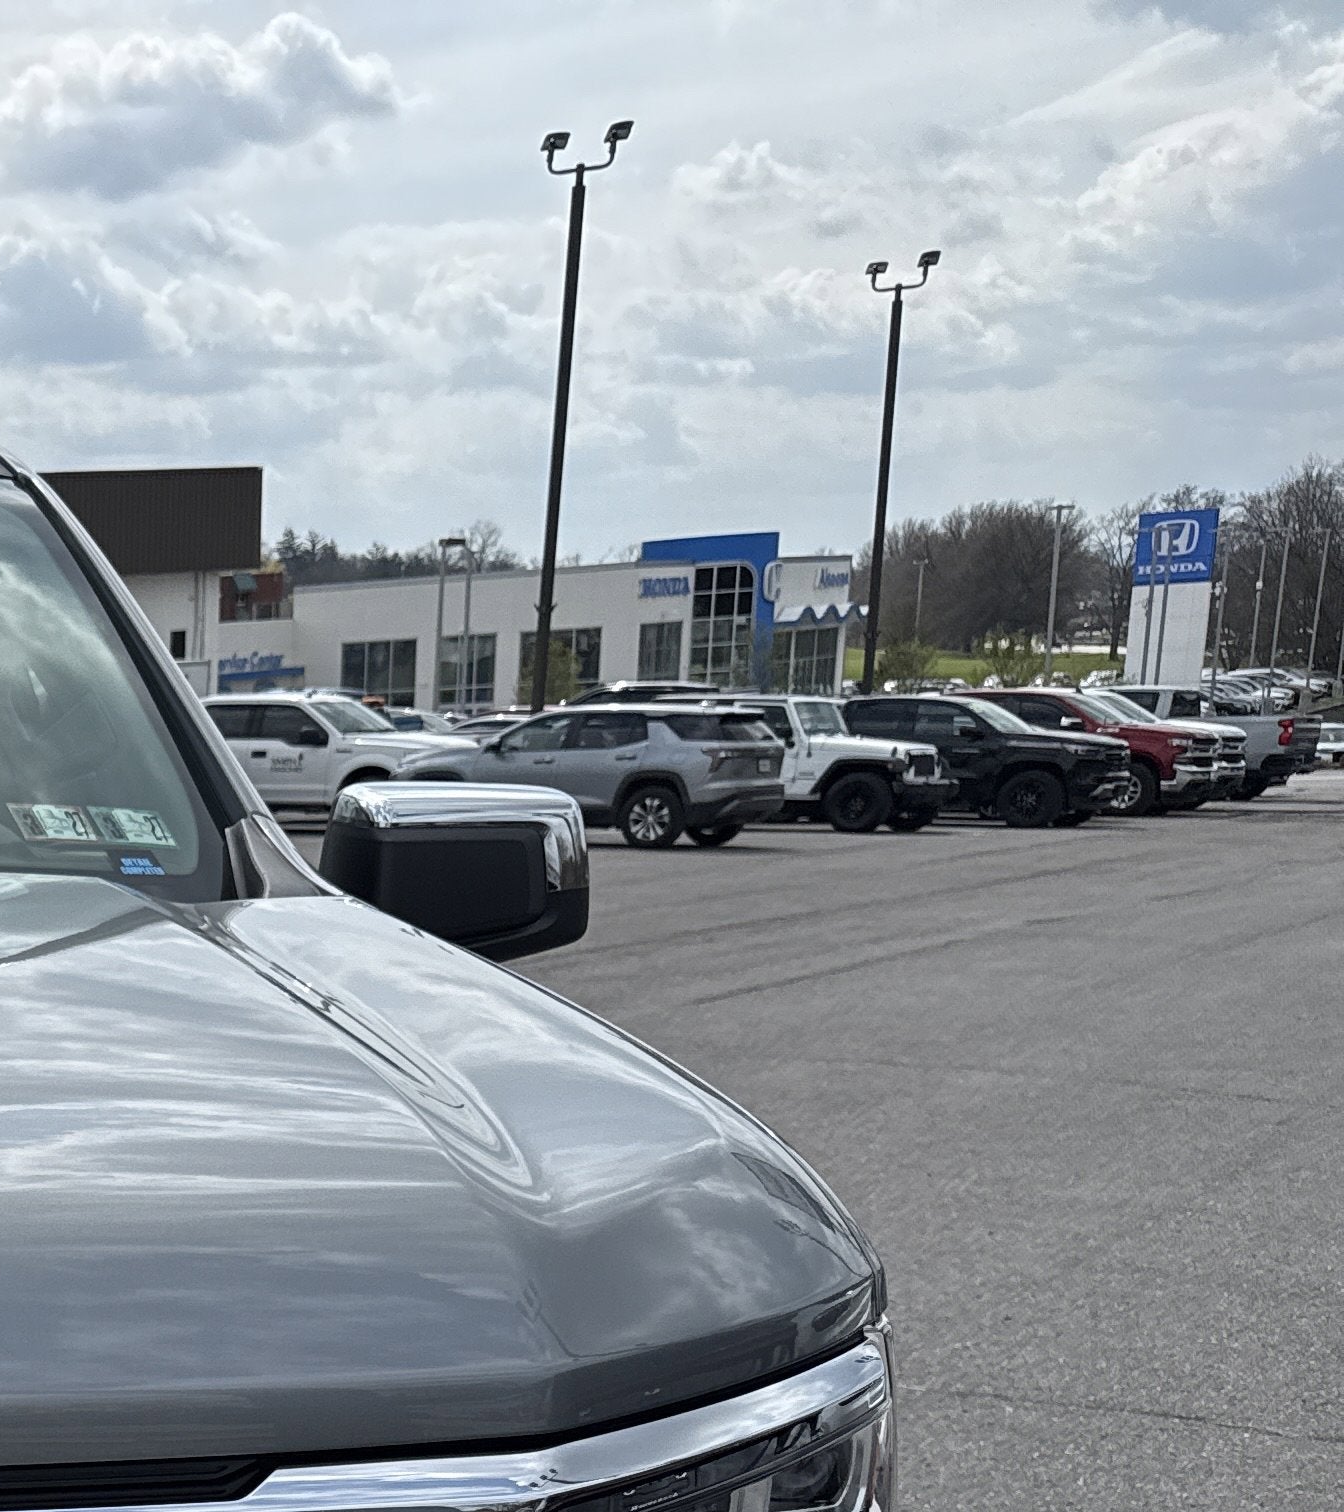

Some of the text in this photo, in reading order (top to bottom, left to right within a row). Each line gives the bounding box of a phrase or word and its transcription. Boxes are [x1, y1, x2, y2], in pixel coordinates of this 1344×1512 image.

[1135, 561, 1208, 575] HONDA
[64, 811, 90, 839] 27
[143, 815, 169, 842] 27
